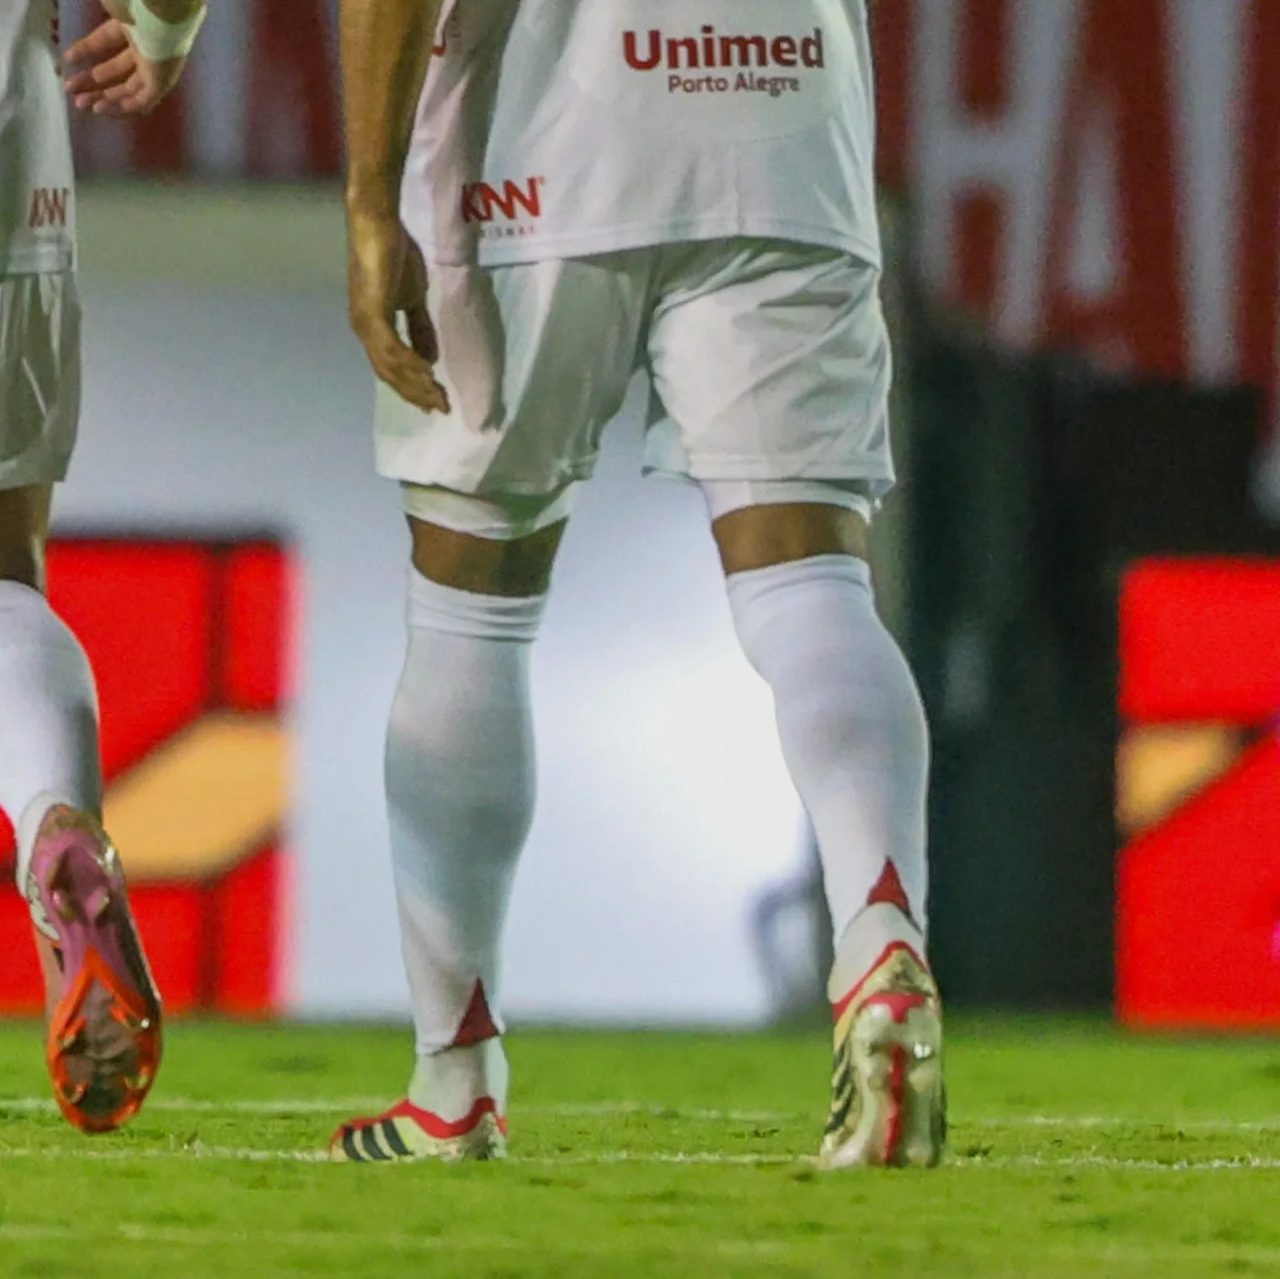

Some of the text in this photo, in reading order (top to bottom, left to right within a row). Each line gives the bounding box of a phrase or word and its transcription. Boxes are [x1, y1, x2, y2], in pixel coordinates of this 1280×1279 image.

[623, 24, 824, 70] Unimed
[668, 71, 800, 98] Porto Alegre
